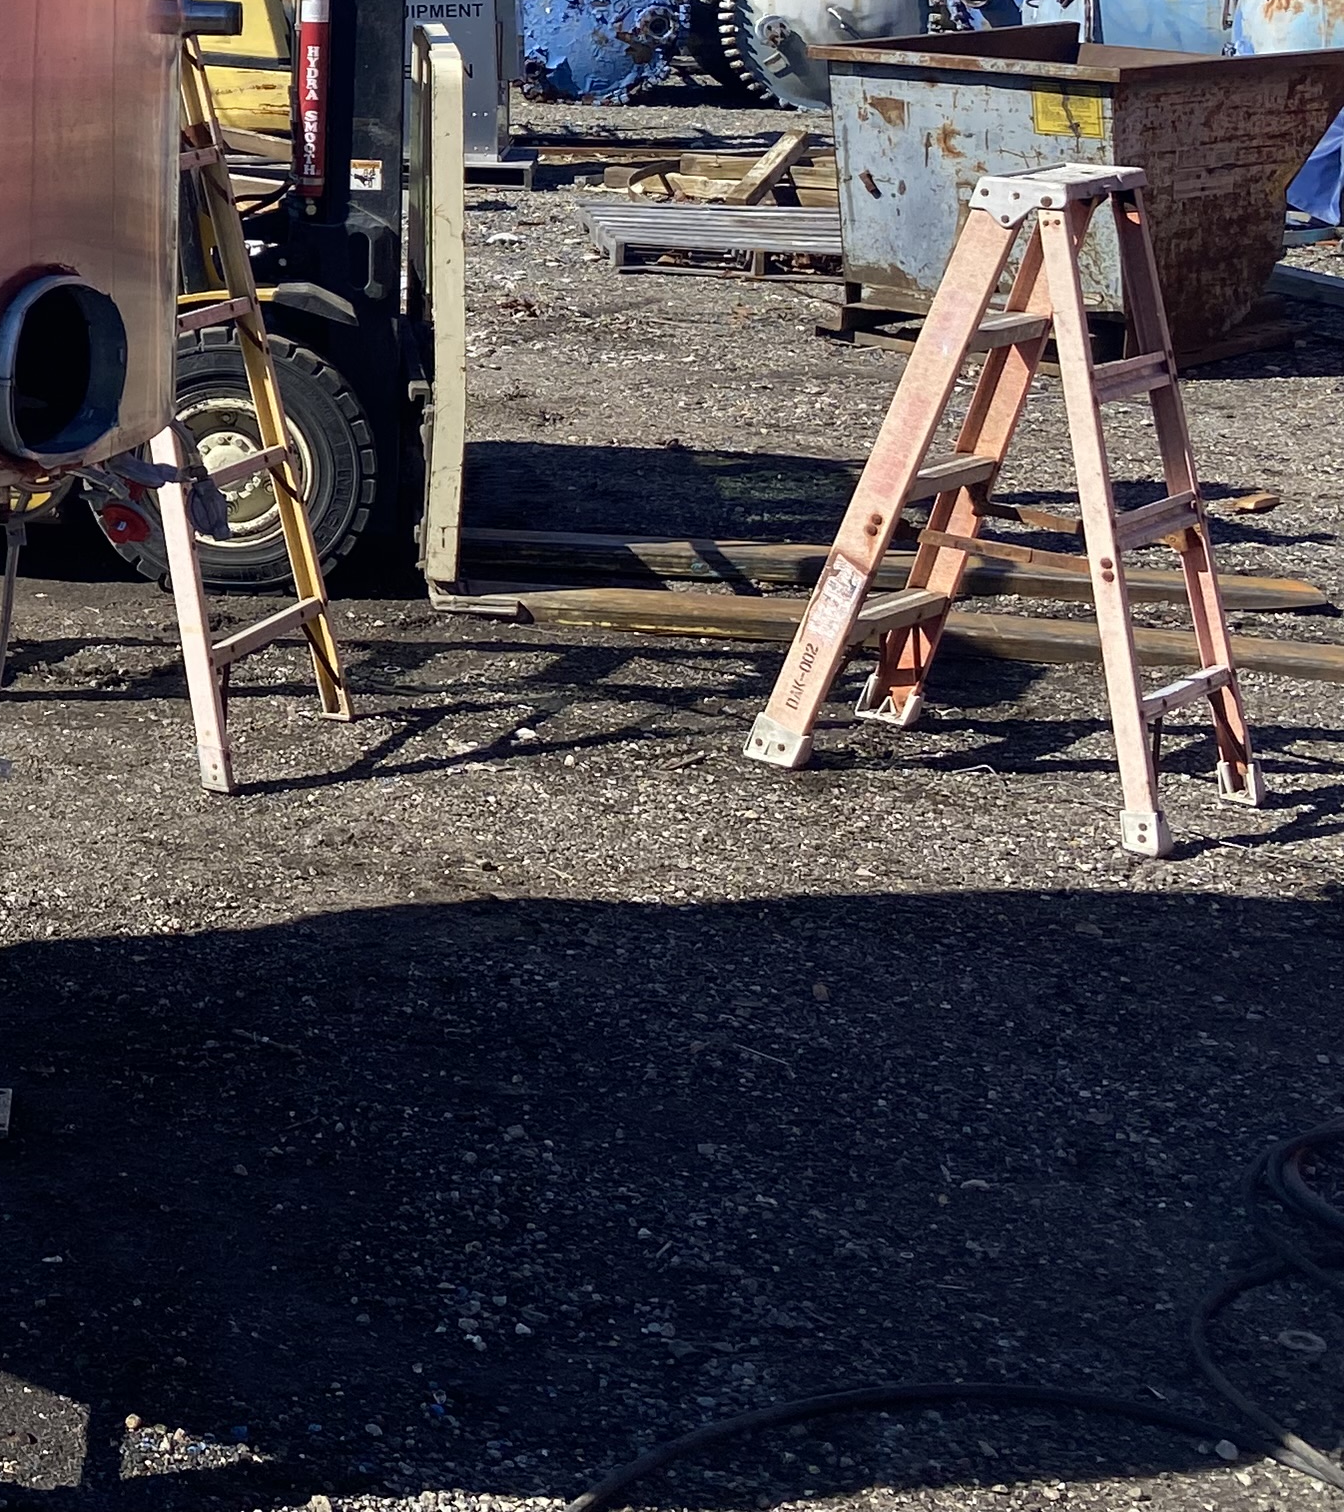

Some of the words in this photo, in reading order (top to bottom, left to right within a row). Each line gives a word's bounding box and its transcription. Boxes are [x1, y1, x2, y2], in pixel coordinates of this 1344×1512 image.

[305, 45, 320, 101] HYDRA
[303, 110, 319, 175] SMOOTH
[785, 642, 819, 711] DAK-002
